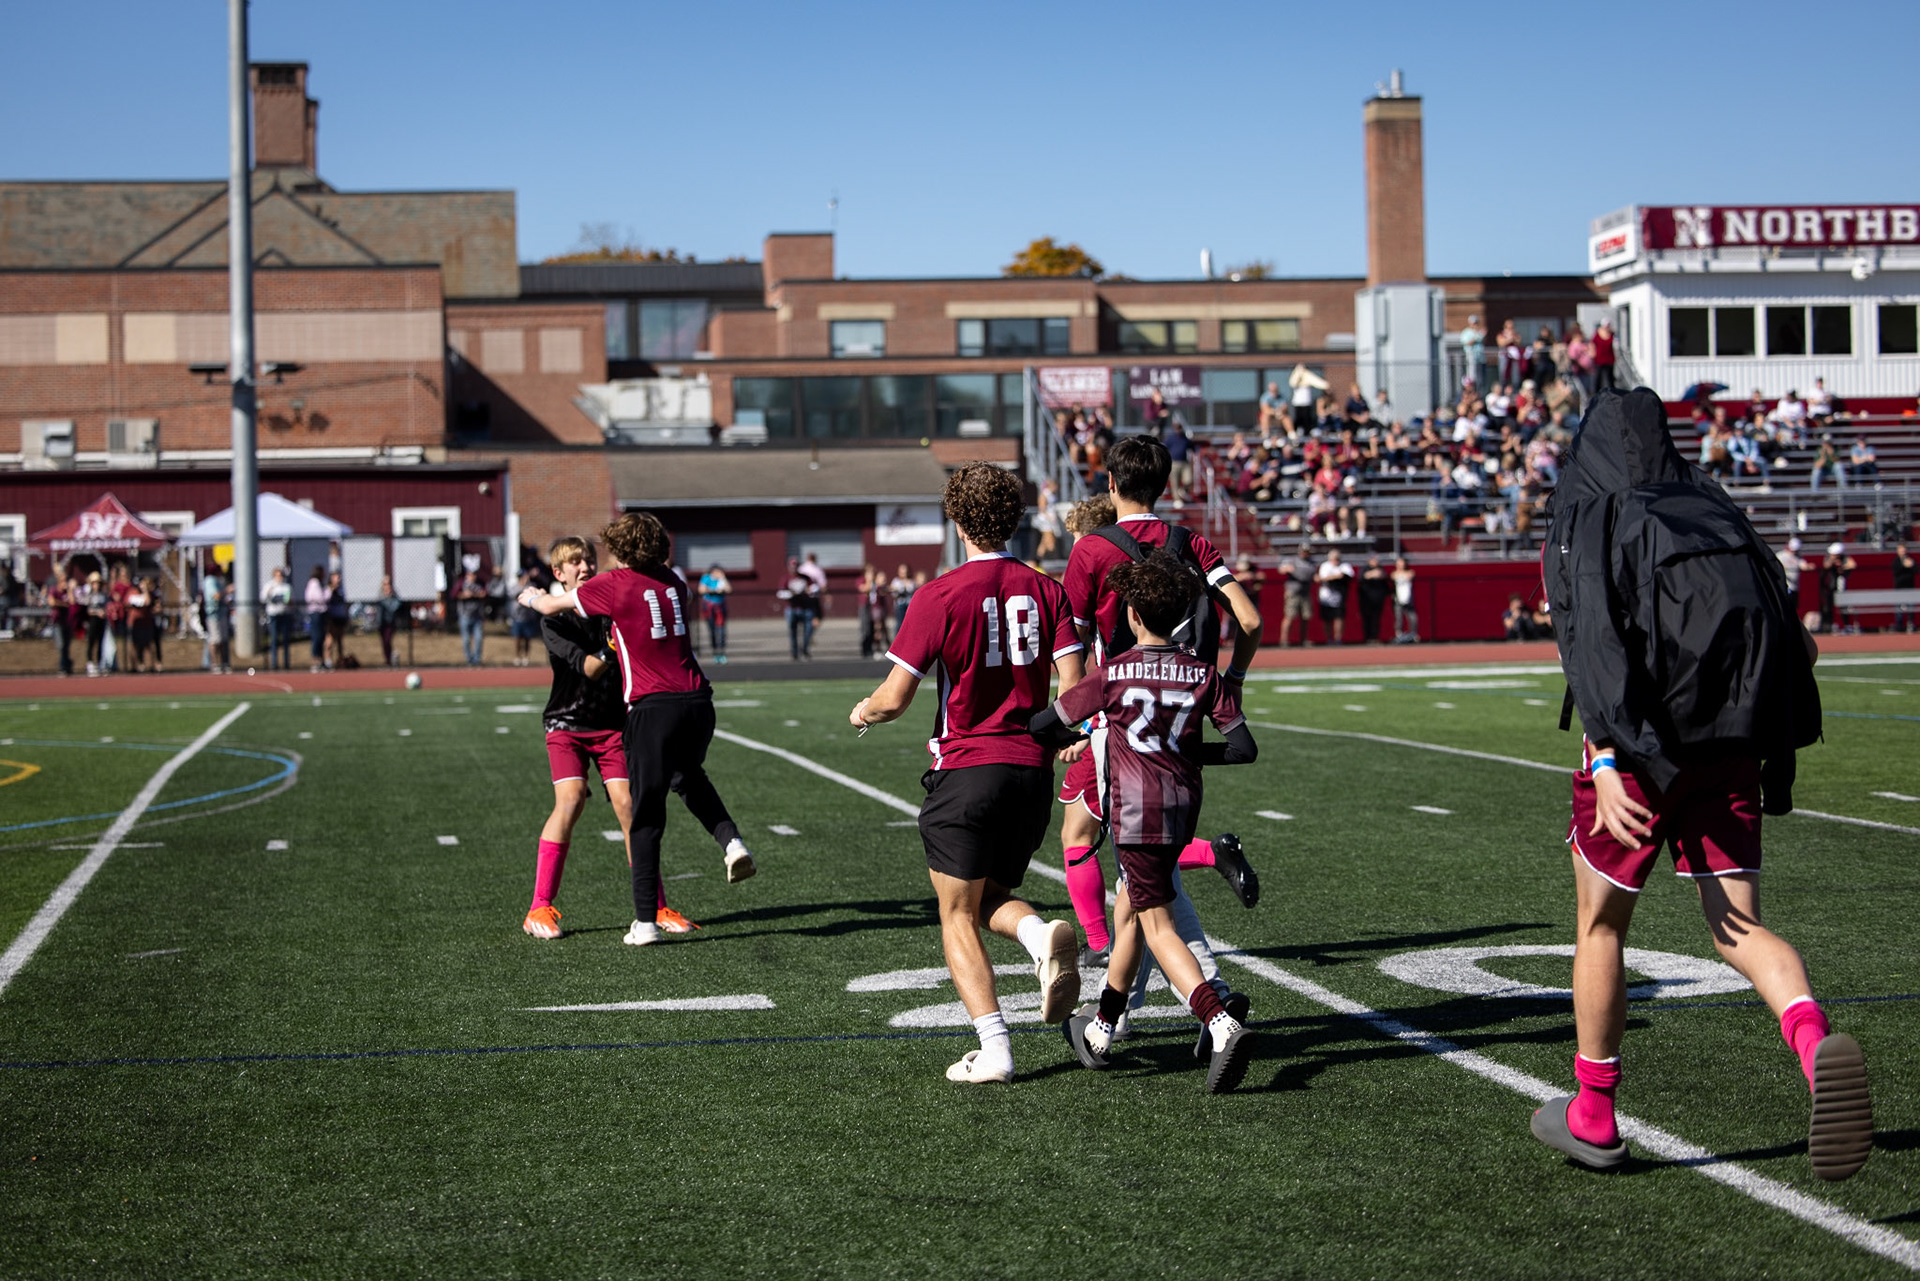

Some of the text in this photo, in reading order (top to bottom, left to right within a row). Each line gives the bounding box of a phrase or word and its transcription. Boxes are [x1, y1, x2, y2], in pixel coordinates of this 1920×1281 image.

[1673, 207, 1918, 247] N NORTHB
[643, 586, 686, 640] 11
[982, 595, 1040, 667] 18
[1107, 661, 1207, 685] MANDELENAKIS
[1121, 686, 1196, 753] 27
